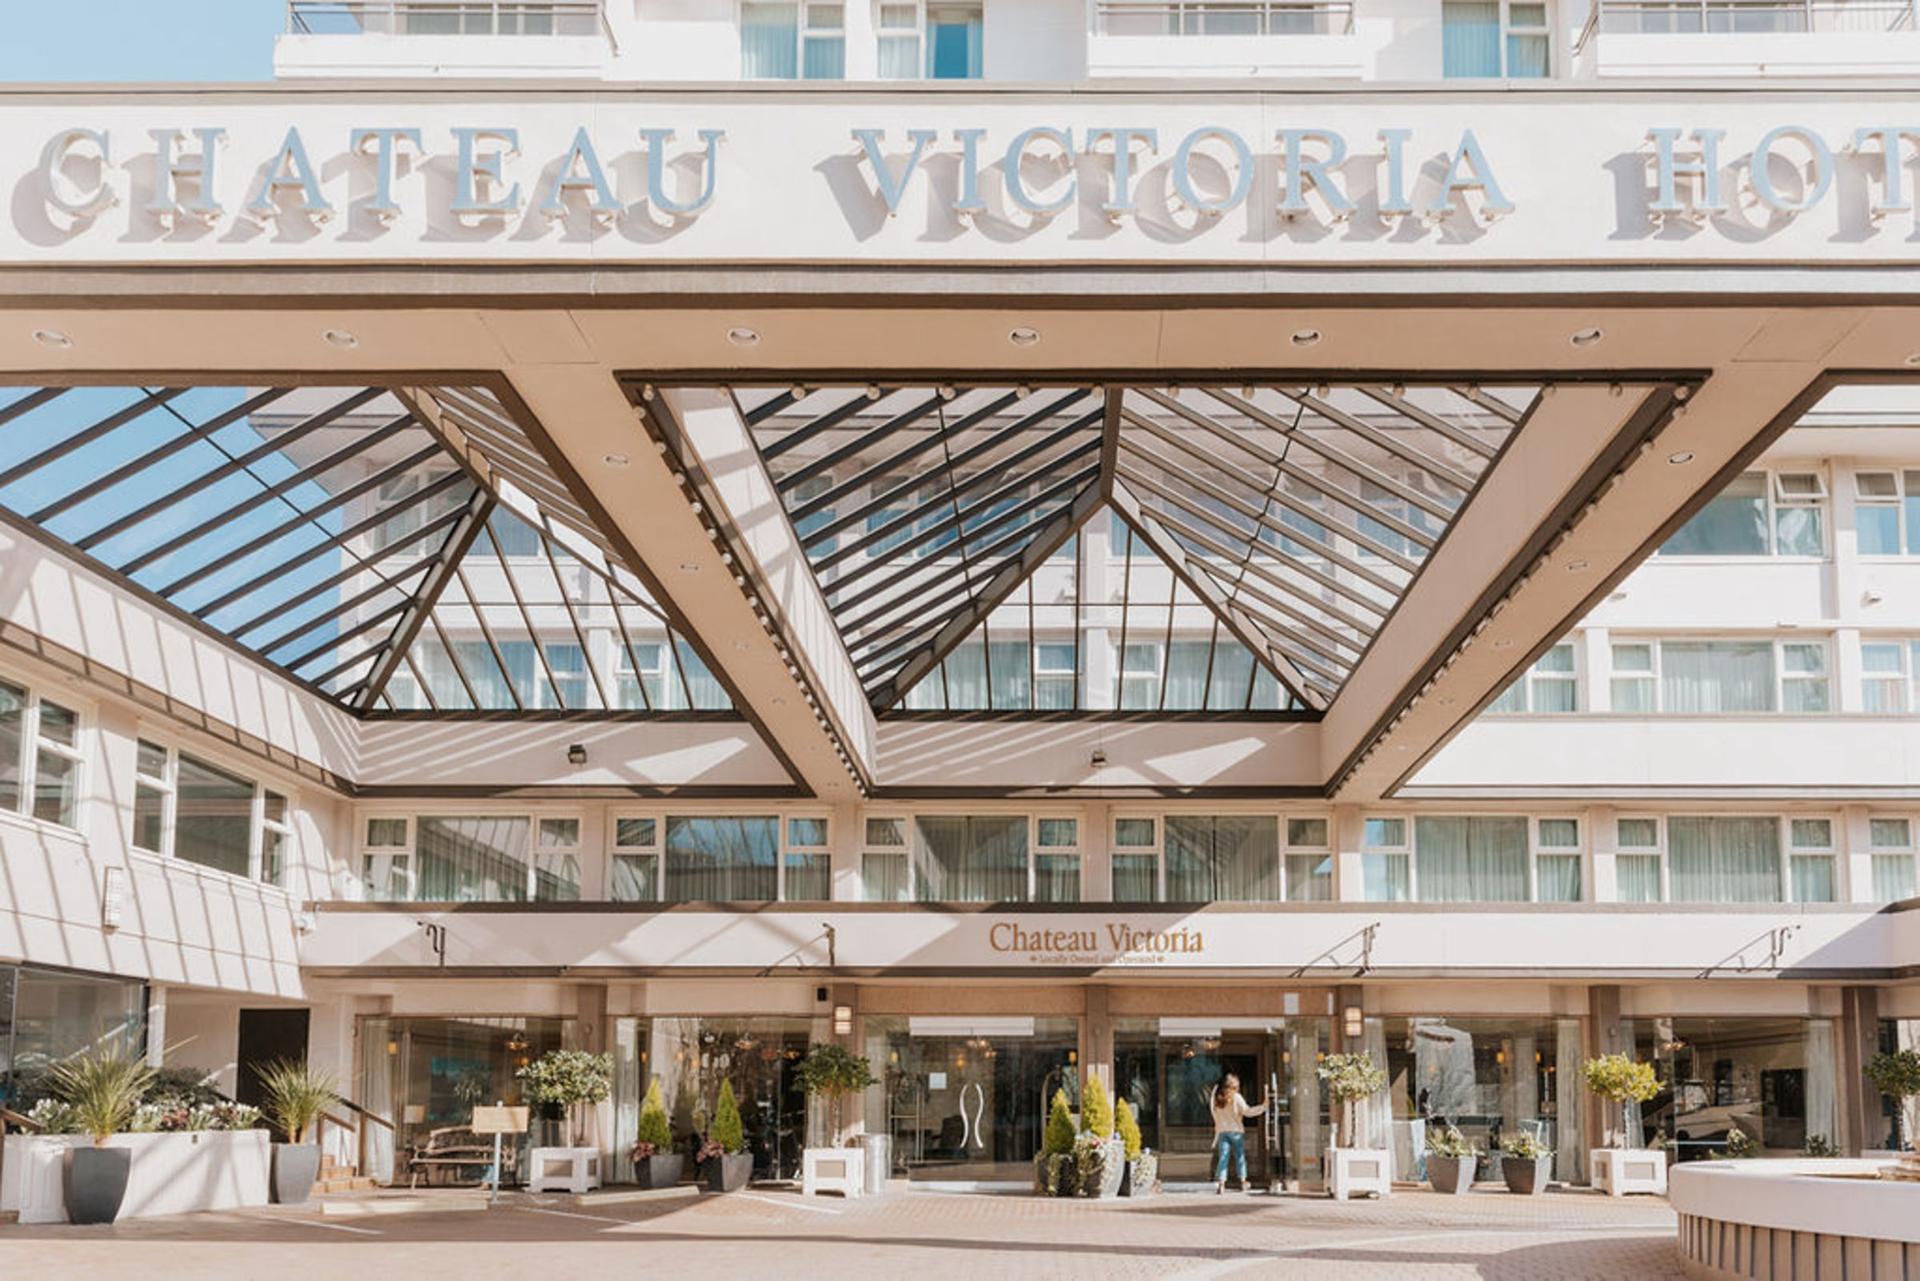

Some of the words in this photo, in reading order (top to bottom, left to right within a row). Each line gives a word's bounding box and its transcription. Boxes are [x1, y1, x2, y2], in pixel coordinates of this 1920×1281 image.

[38, 125, 727, 213] CHATEAU
[850, 126, 1517, 215] VICTORIA
[1645, 125, 1920, 213] HOT
[989, 922, 1098, 952] Chateau
[1105, 922, 1204, 953] Victoria
